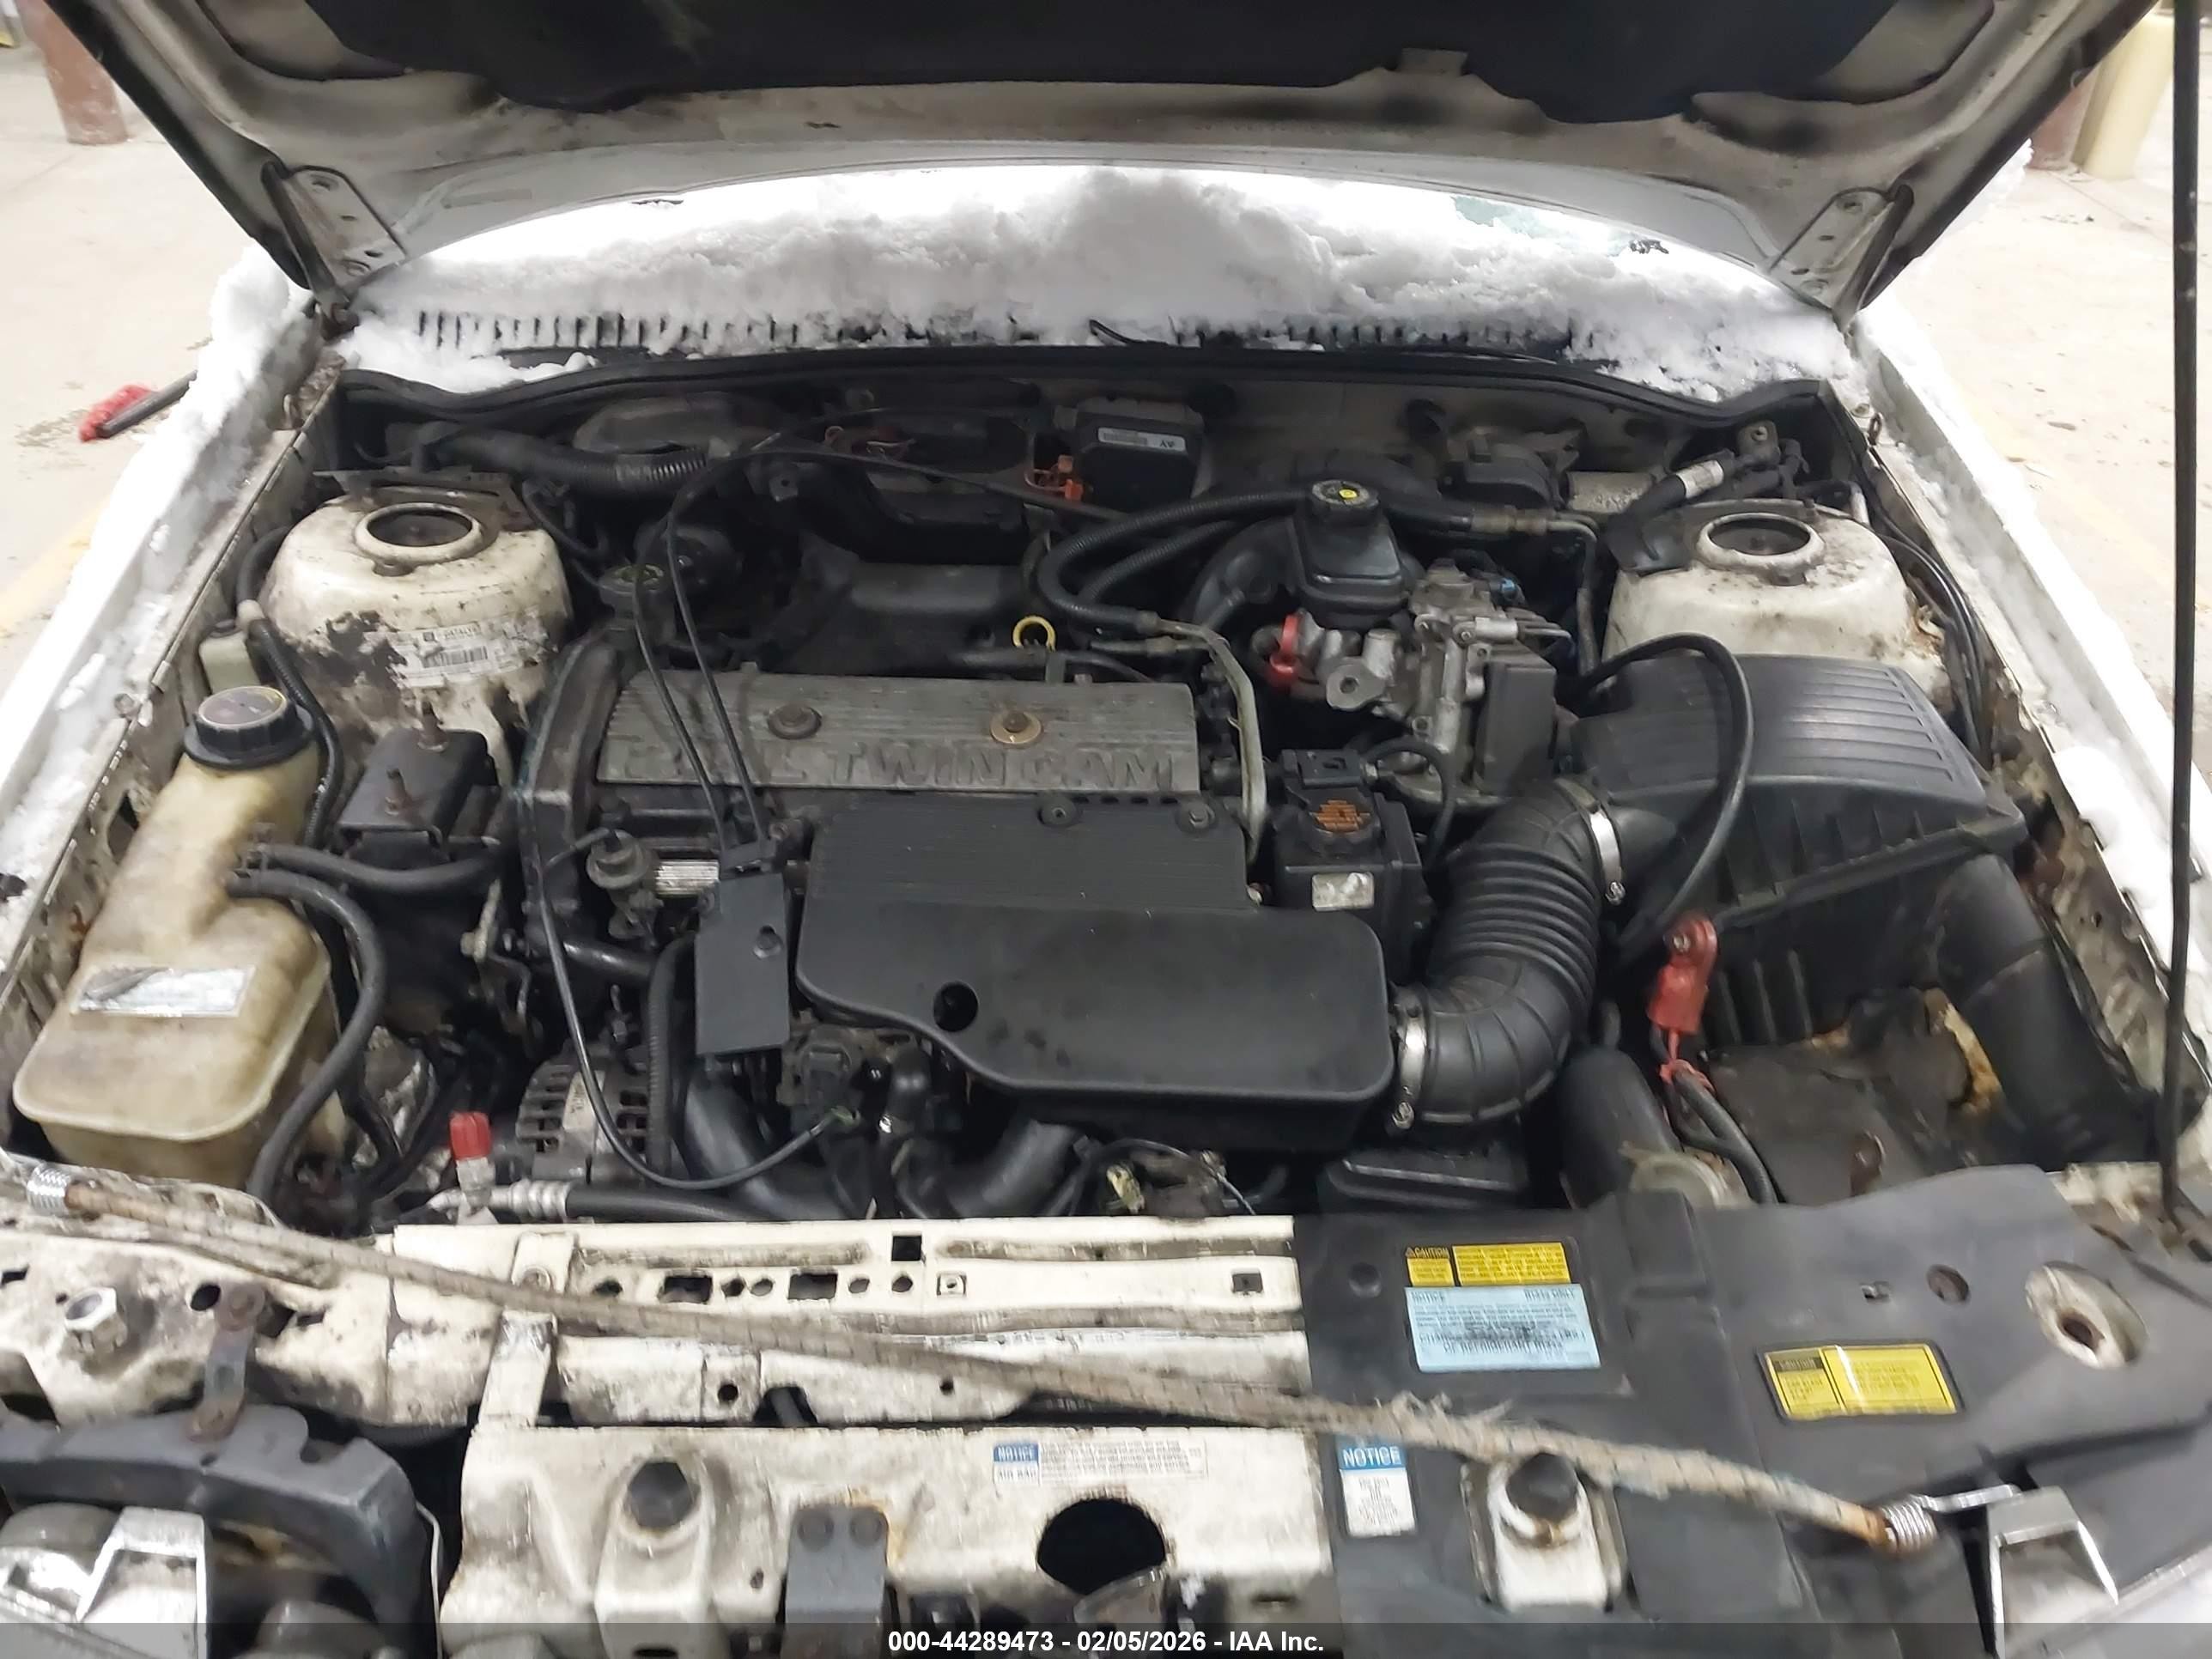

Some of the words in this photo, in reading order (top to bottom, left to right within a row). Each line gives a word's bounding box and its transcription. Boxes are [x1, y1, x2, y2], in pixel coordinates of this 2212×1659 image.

[827, 741, 1007, 787] TWIN
[1022, 747, 1176, 791] CAM
[1414, 1247, 1450, 1259] CAUTION
[1342, 1446, 1402, 1468] NOTICE
